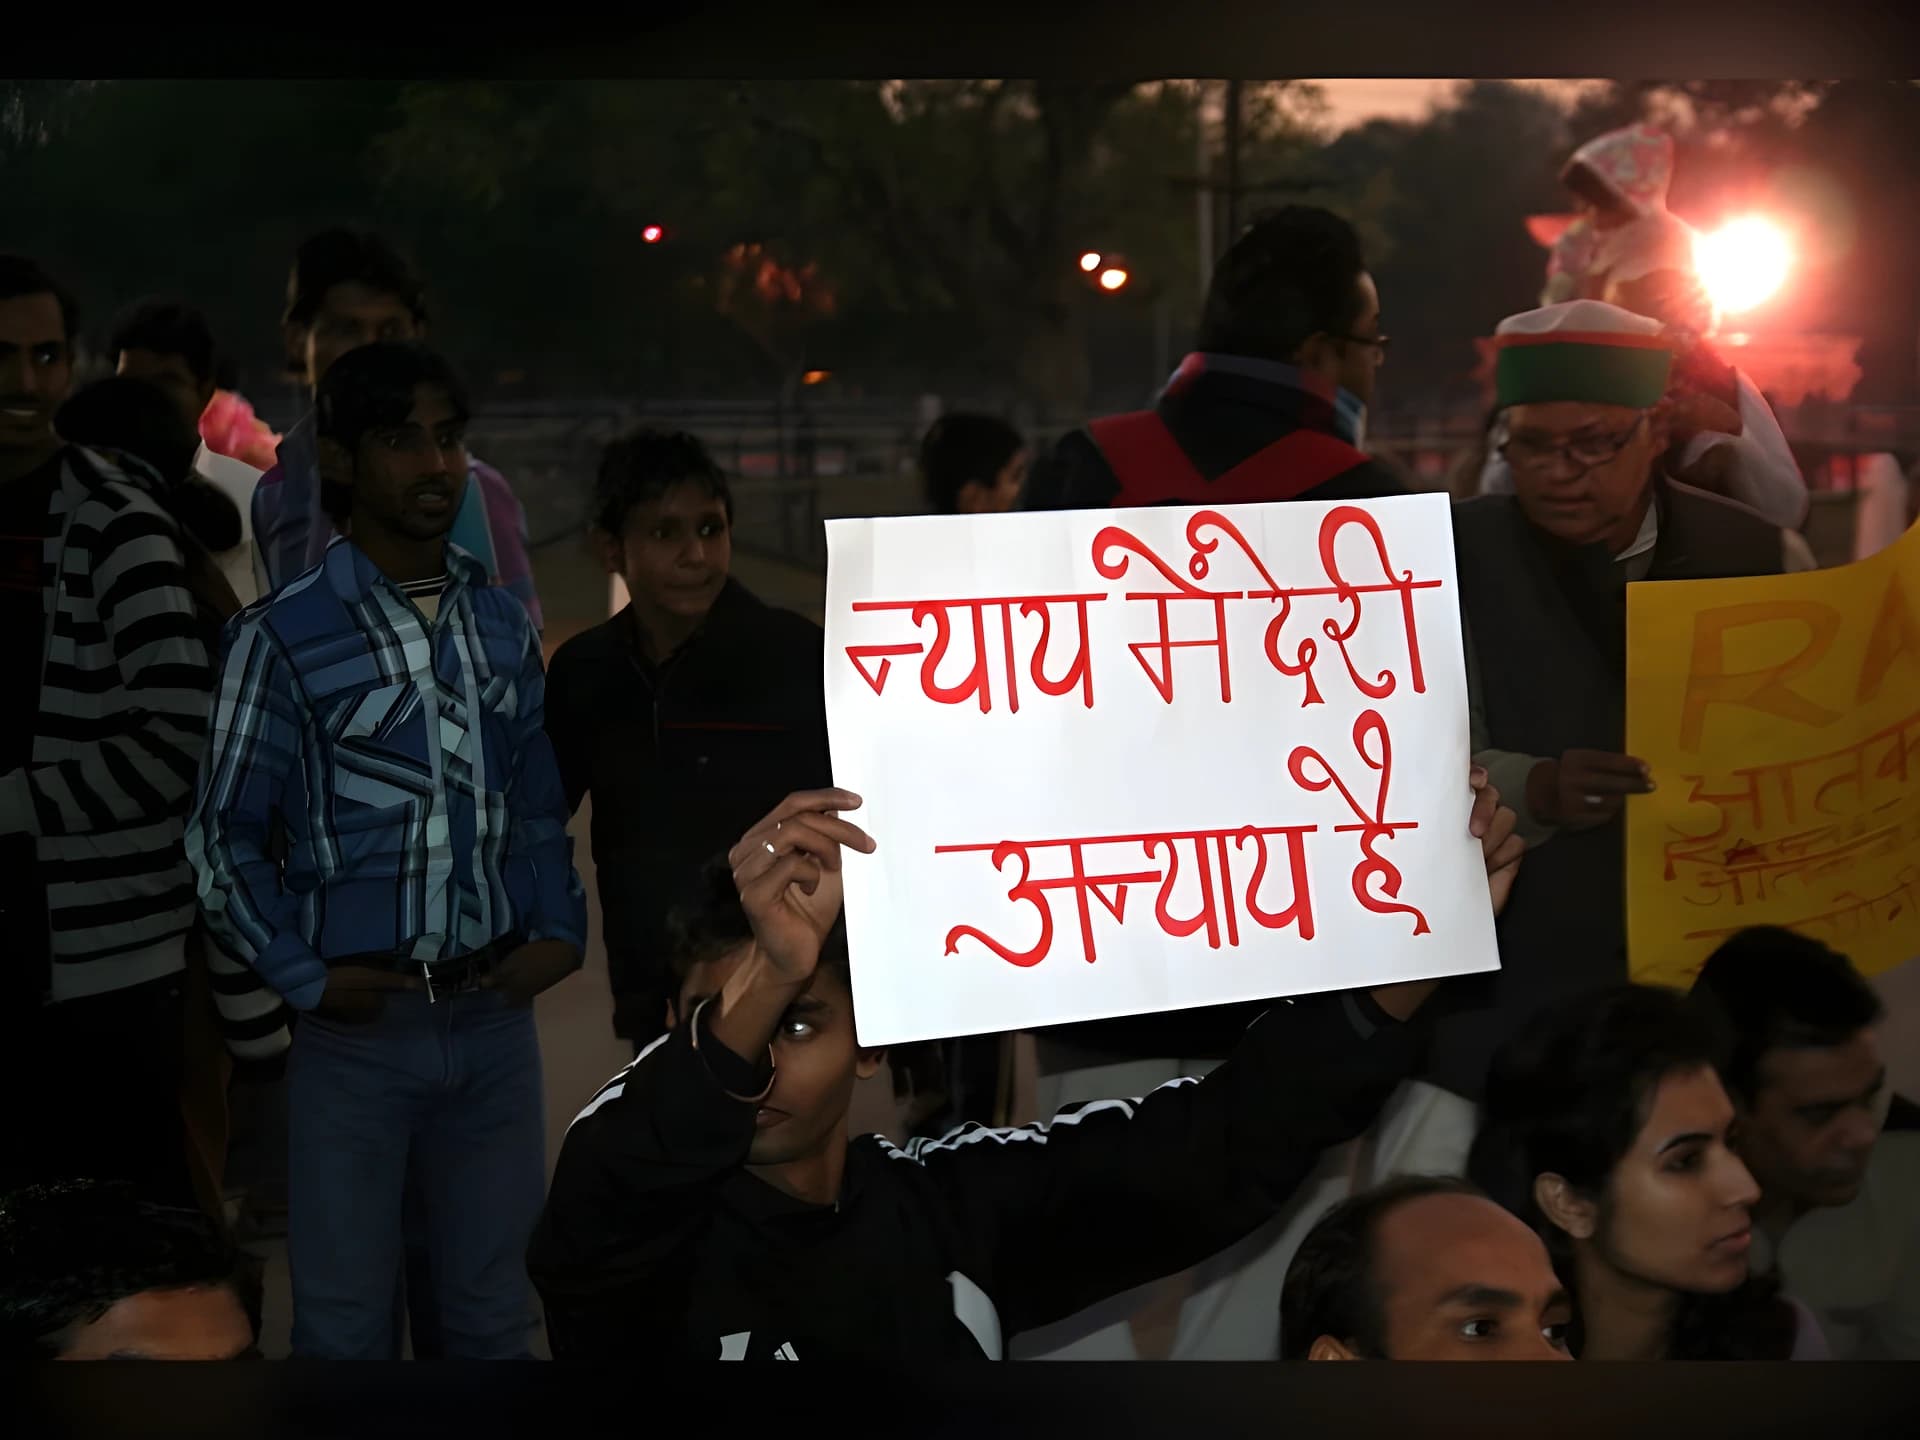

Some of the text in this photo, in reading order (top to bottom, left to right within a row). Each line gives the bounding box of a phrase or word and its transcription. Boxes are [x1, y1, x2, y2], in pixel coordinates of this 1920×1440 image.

[846, 592, 1108, 714] न्याय
[1186, 505, 1443, 708] देरी
[934, 709, 1430, 968] अन्याय है
